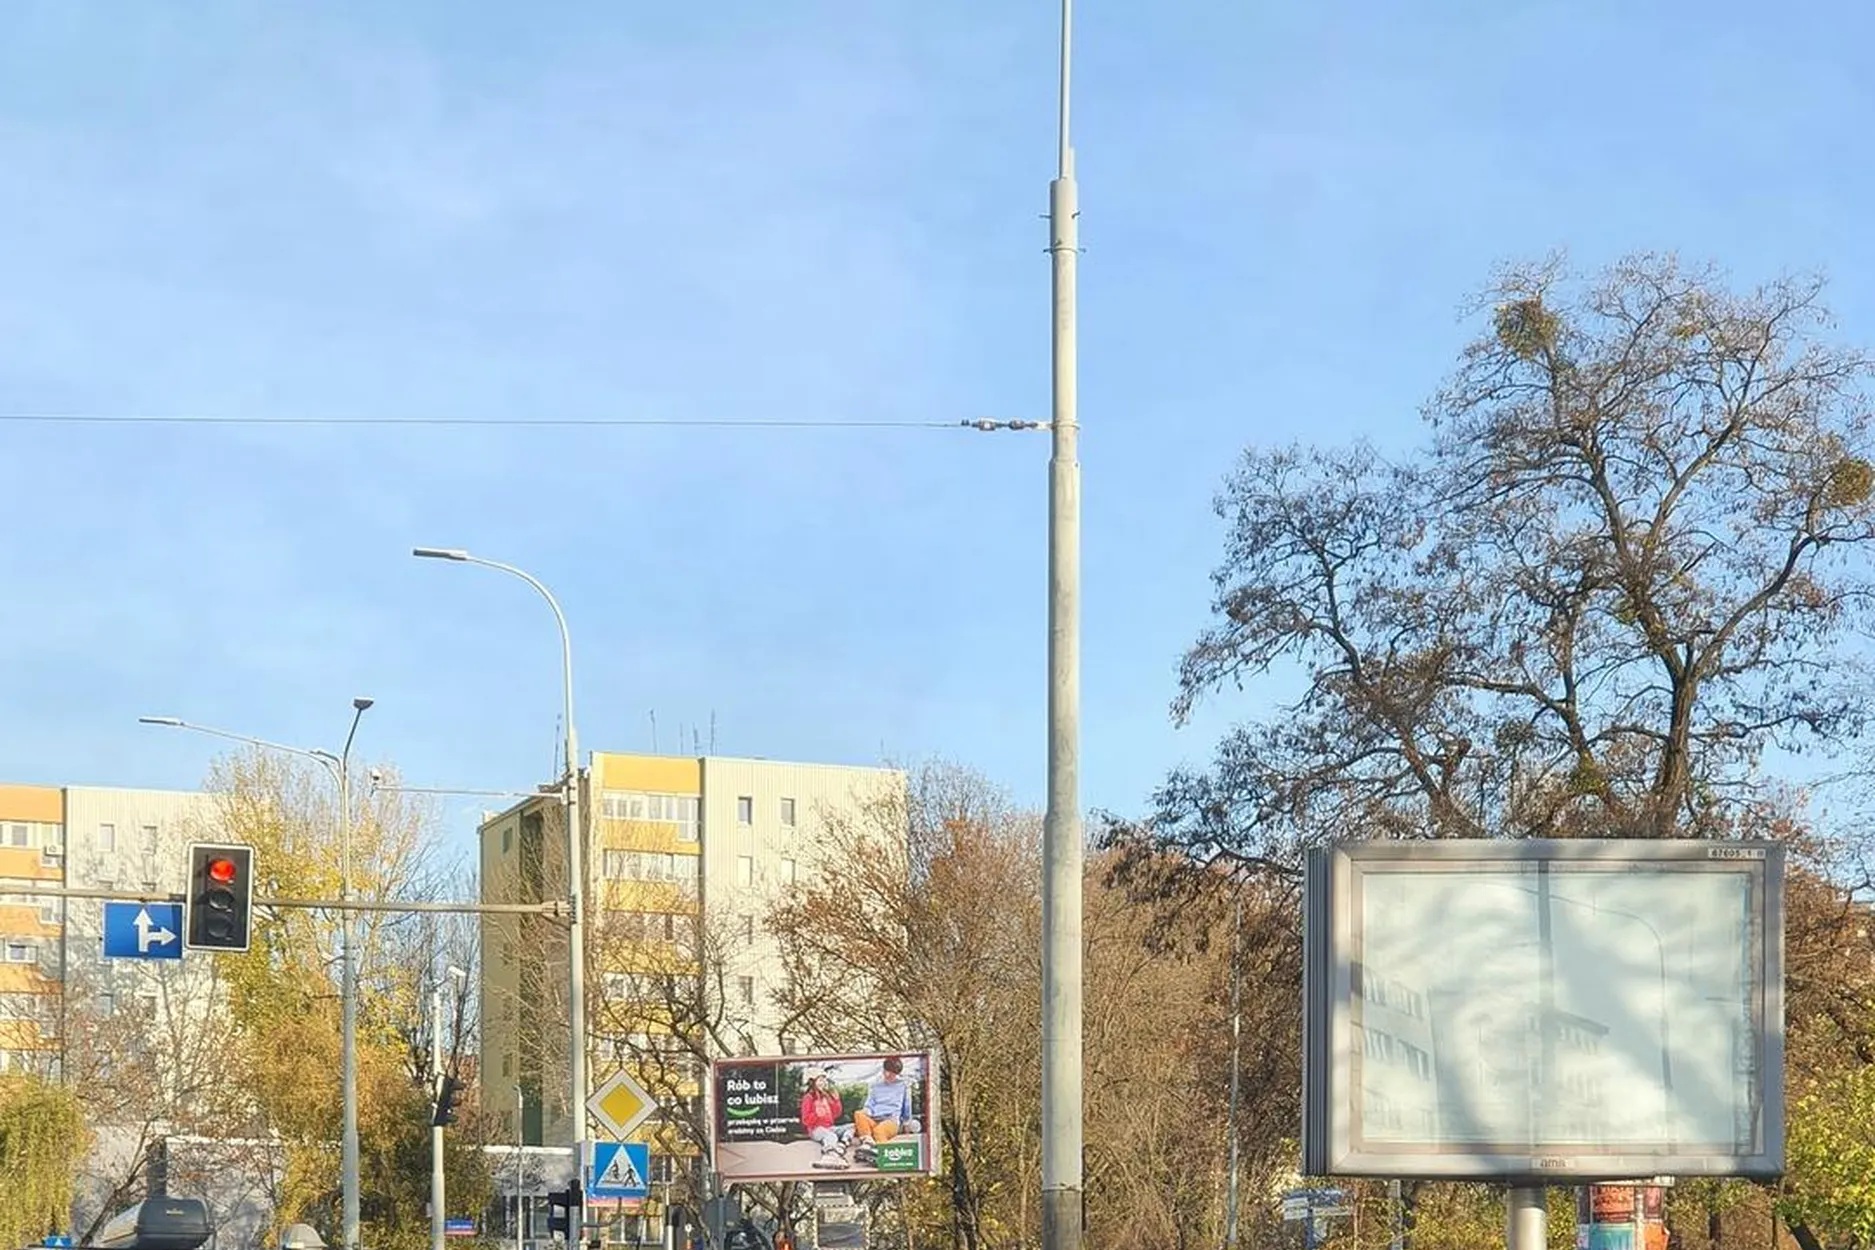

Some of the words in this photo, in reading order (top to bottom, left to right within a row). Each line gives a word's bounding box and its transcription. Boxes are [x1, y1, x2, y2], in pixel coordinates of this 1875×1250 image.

[727, 1079, 751, 1091] Rób
[753, 1080, 767, 1090] to
[727, 1096, 742, 1106] co
[744, 1092, 779, 1105] lubisz
